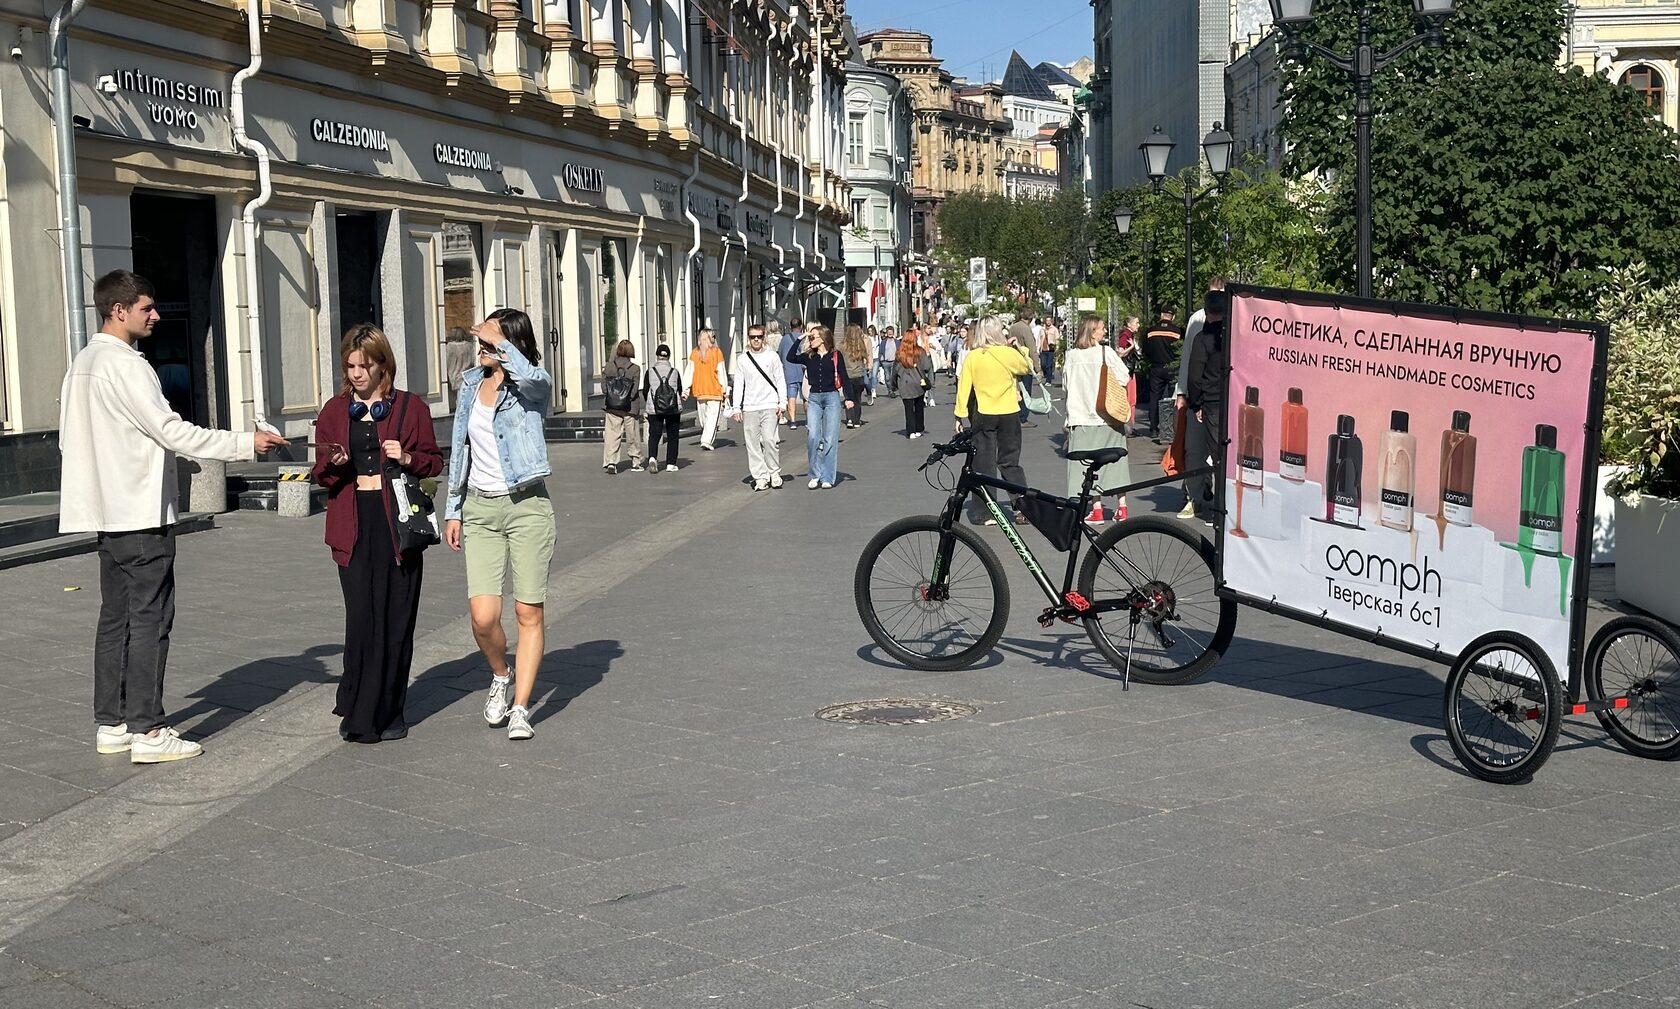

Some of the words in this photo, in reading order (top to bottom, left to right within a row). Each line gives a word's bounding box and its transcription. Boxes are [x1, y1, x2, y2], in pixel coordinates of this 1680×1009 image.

[151, 103, 198, 129] UOMO
[312, 118, 389, 151] CALZEDONIA
[435, 143, 492, 171] CALZEDONIA
[564, 163, 605, 192] OSKELLY
[1251, 315, 1348, 348] КОСМЕТИКА,
[1354, 330, 1464, 360] СДЕЛАННАЯ
[1469, 344, 1562, 373] ВРУЧНУЮ
[1268, 346, 1318, 367] RUSSIAN
[1322, 355, 1362, 374] FRESH
[1366, 361, 1447, 387] HANDMADE
[1451, 374, 1536, 400] COSMETICS
[1383, 492, 1407, 504] oomph
[1445, 492, 1468, 504] oomph
[1529, 517, 1556, 528] oomph
[1326, 544, 1441, 600] oomph
[1325, 576, 1403, 617] Тверская
[1409, 601, 1441, 628] 6с1
